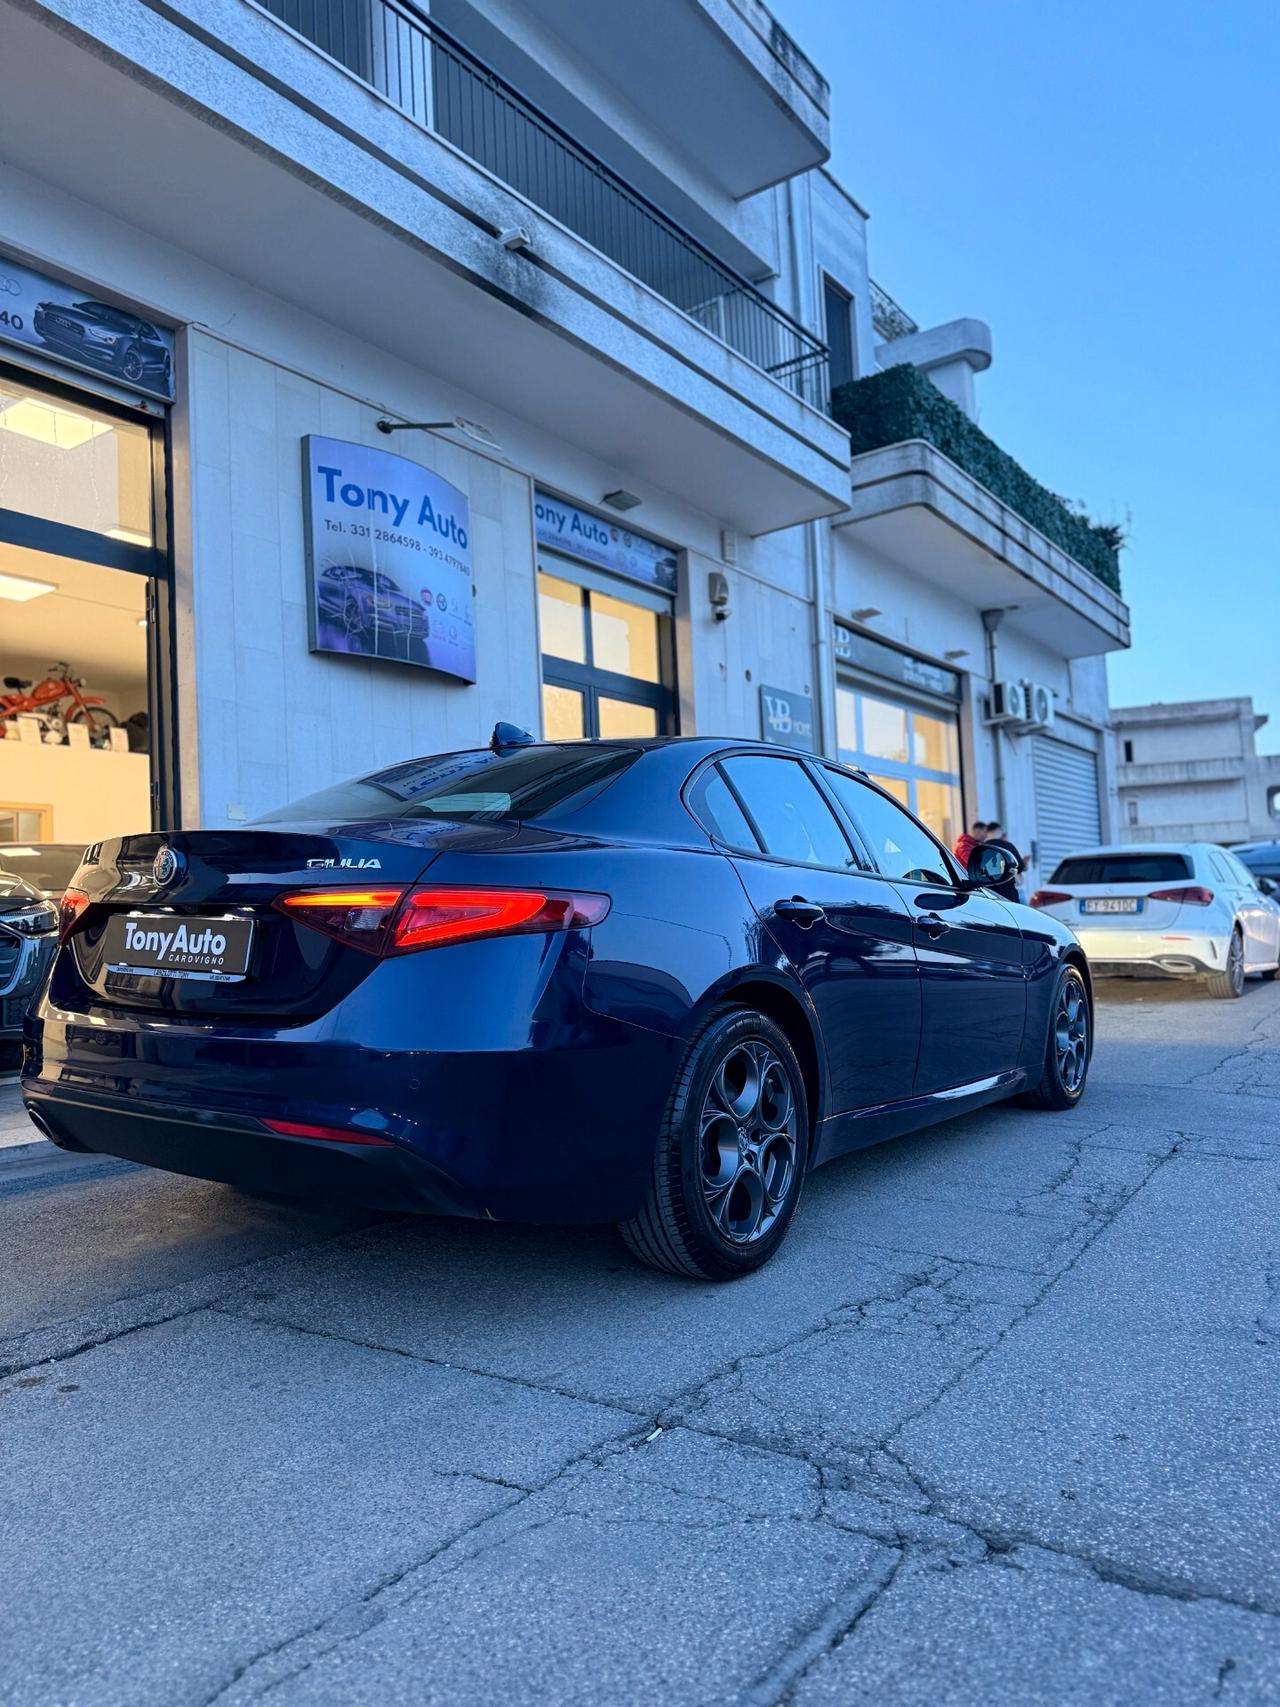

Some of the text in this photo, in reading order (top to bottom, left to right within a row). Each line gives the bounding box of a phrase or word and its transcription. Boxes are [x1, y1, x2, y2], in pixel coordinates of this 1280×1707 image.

[317, 465, 410, 527] Tony
[417, 494, 468, 550] Auto
[324, 519, 347, 533] Tel.
[350, 524, 370, 537] 331
[375, 528, 421, 552] 2864598
[570, 512, 609, 546] Auto
[306, 858, 382, 869] GIULIA
[125, 922, 227, 961] TonyAuto
[168, 954, 225, 966] CAROVIGNO
